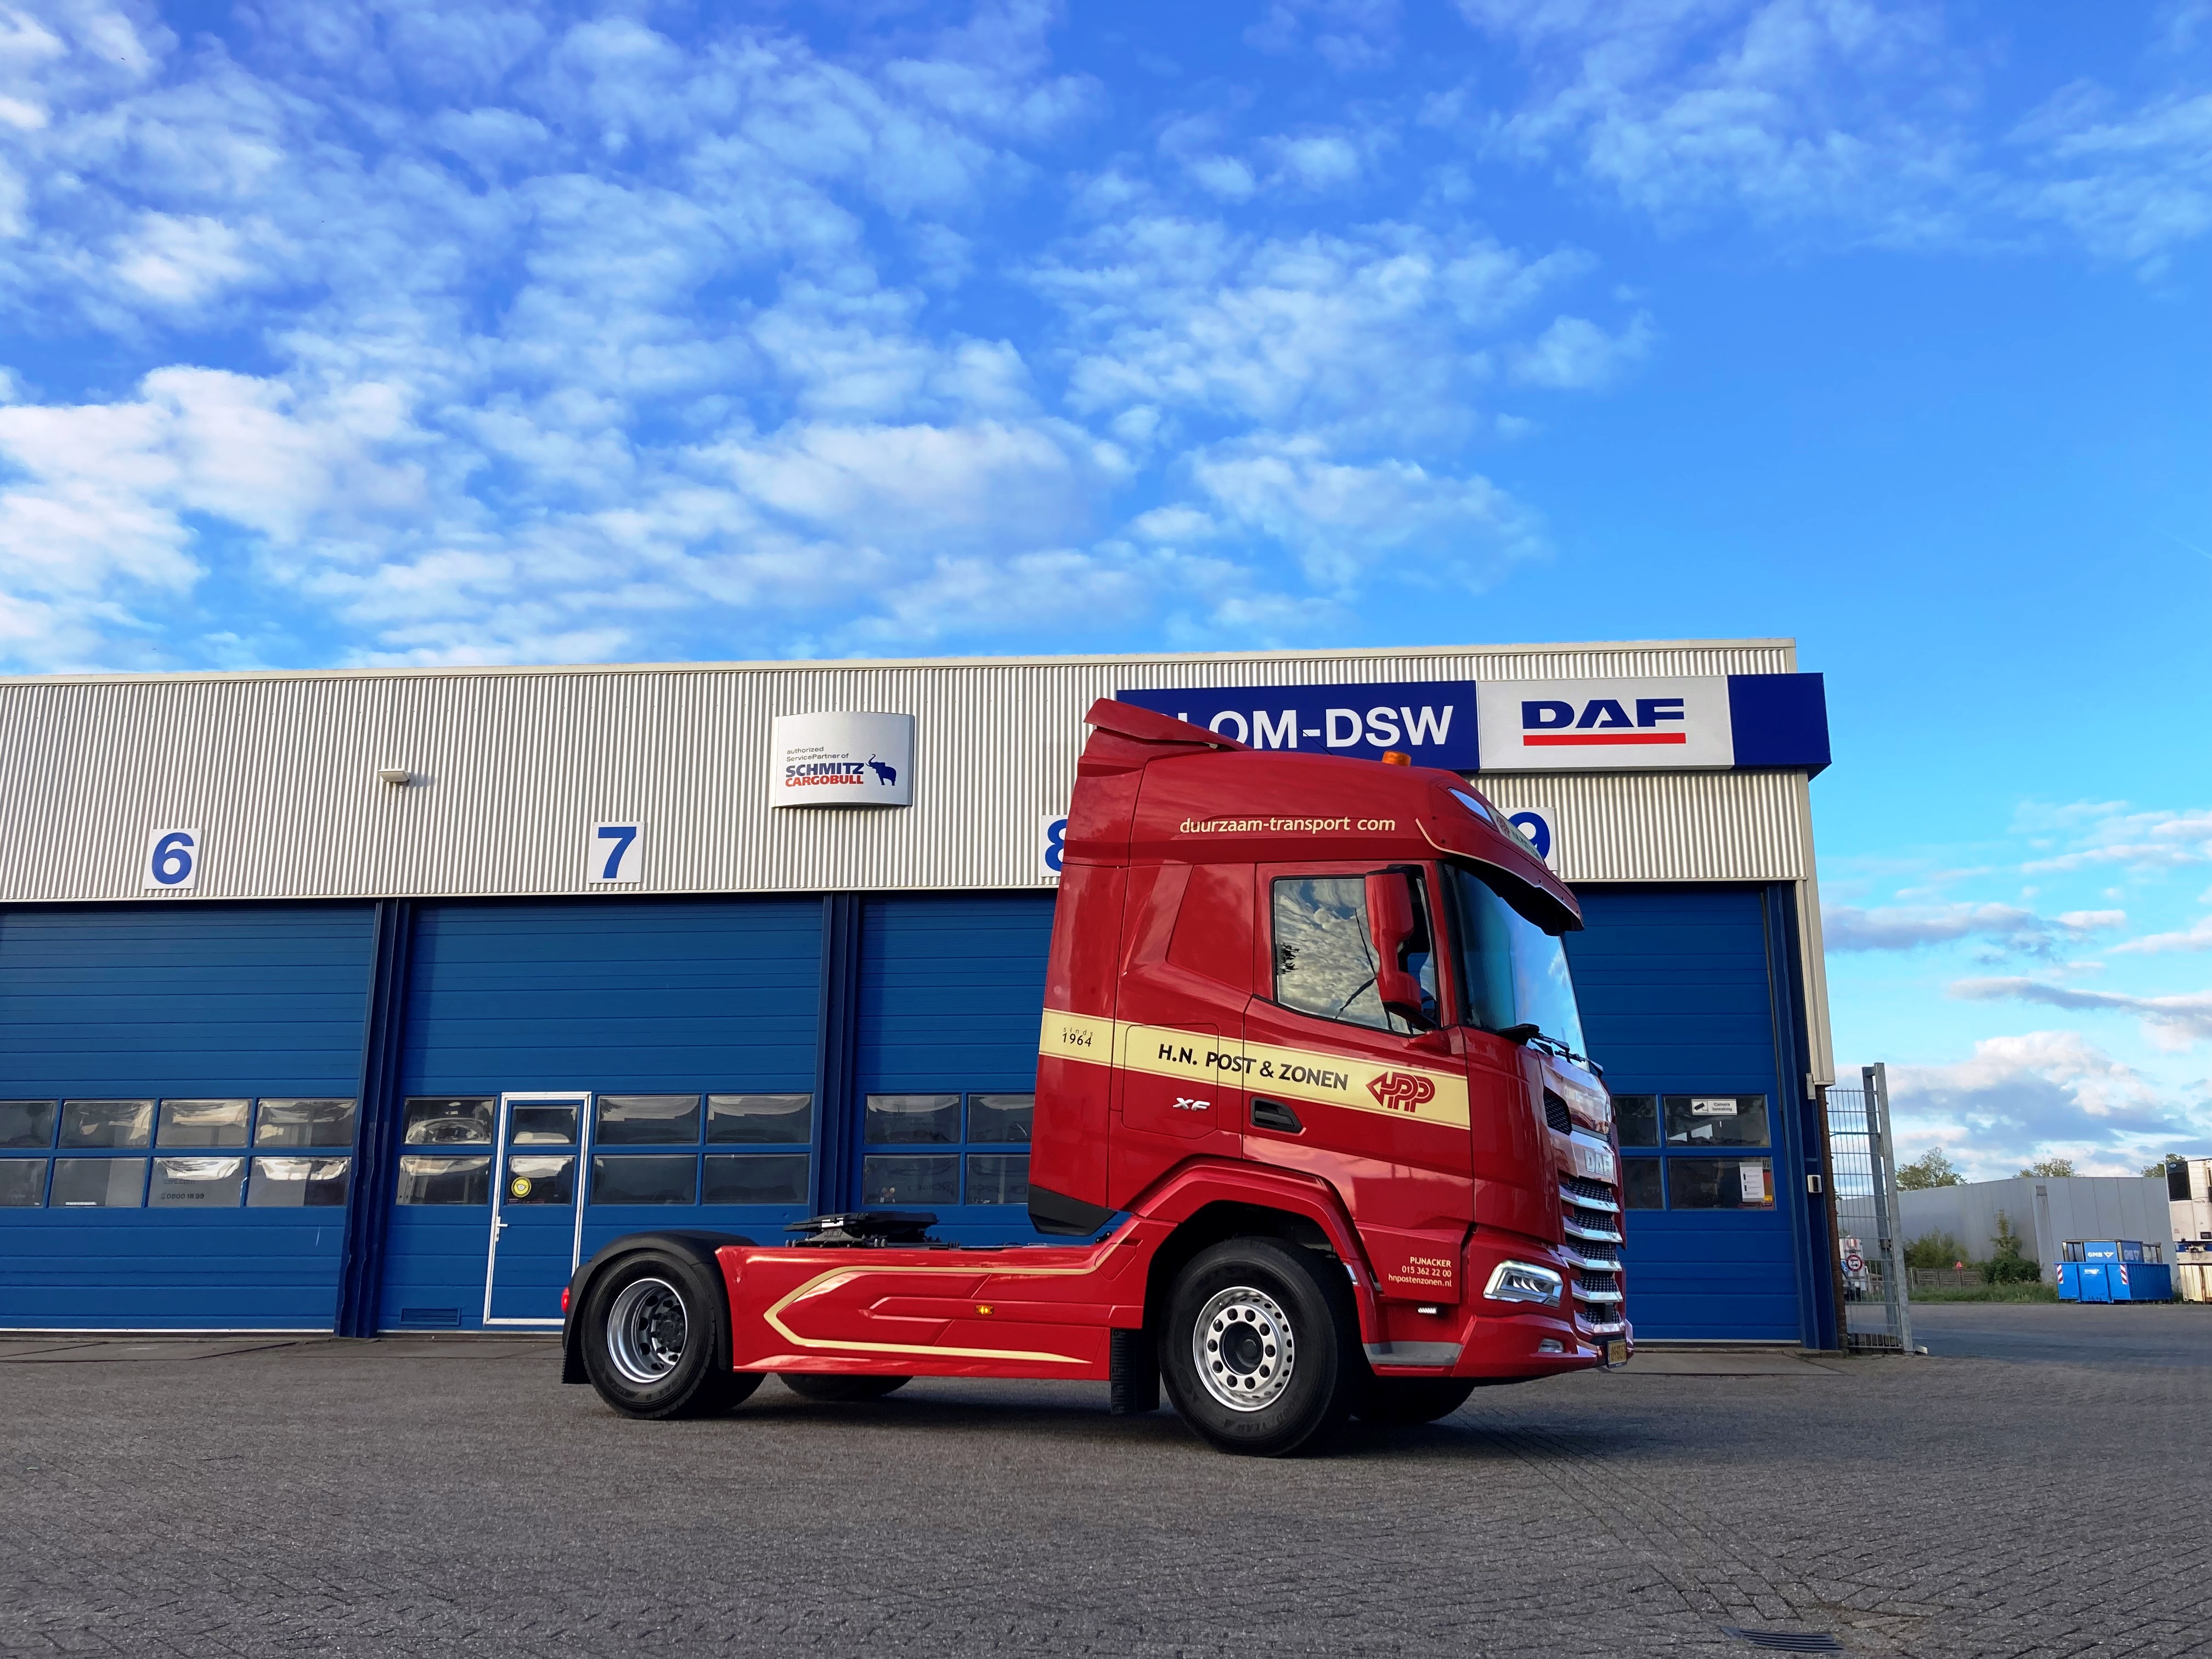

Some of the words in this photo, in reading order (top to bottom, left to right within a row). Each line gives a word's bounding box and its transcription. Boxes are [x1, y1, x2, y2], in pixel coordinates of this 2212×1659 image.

[1521, 698, 1684, 729] DAF
[1161, 706, 1454, 749] OM-DSW
[786, 754, 840, 762] ServicePartner
[787, 746, 824, 754] authorized
[786, 762, 865, 778] SCHMITZ
[785, 775, 864, 787] CARGOBULL
[1180, 816, 1351, 834] duurzaam-transport
[1357, 819, 1396, 831] com
[1508, 811, 1550, 860] 9
[598, 826, 637, 878] 7
[1045, 819, 1068, 872] 8
[151, 832, 194, 884] 6
[1062, 1032, 1092, 1047] 1964
[1063, 1027, 1093, 1037] sinds
[1158, 1043, 1198, 1065] H.N.
[1205, 1051, 1257, 1074] POST
[1259, 1060, 1274, 1078] &
[1278, 1063, 1348, 1091] ZONEN
[1172, 1097, 1210, 1111] XF
[1583, 1148, 1610, 1176] DAF
[1409, 1256, 1452, 1268] PIJNACKER
[1402, 1265, 1415, 1274] 015
[1417, 1267, 1430, 1276] 362
[1431, 1268, 1441, 1277] 22
[1442, 1269, 1452, 1278] 00
[1388, 1273, 1452, 1287] hnpostenzonen.nl
